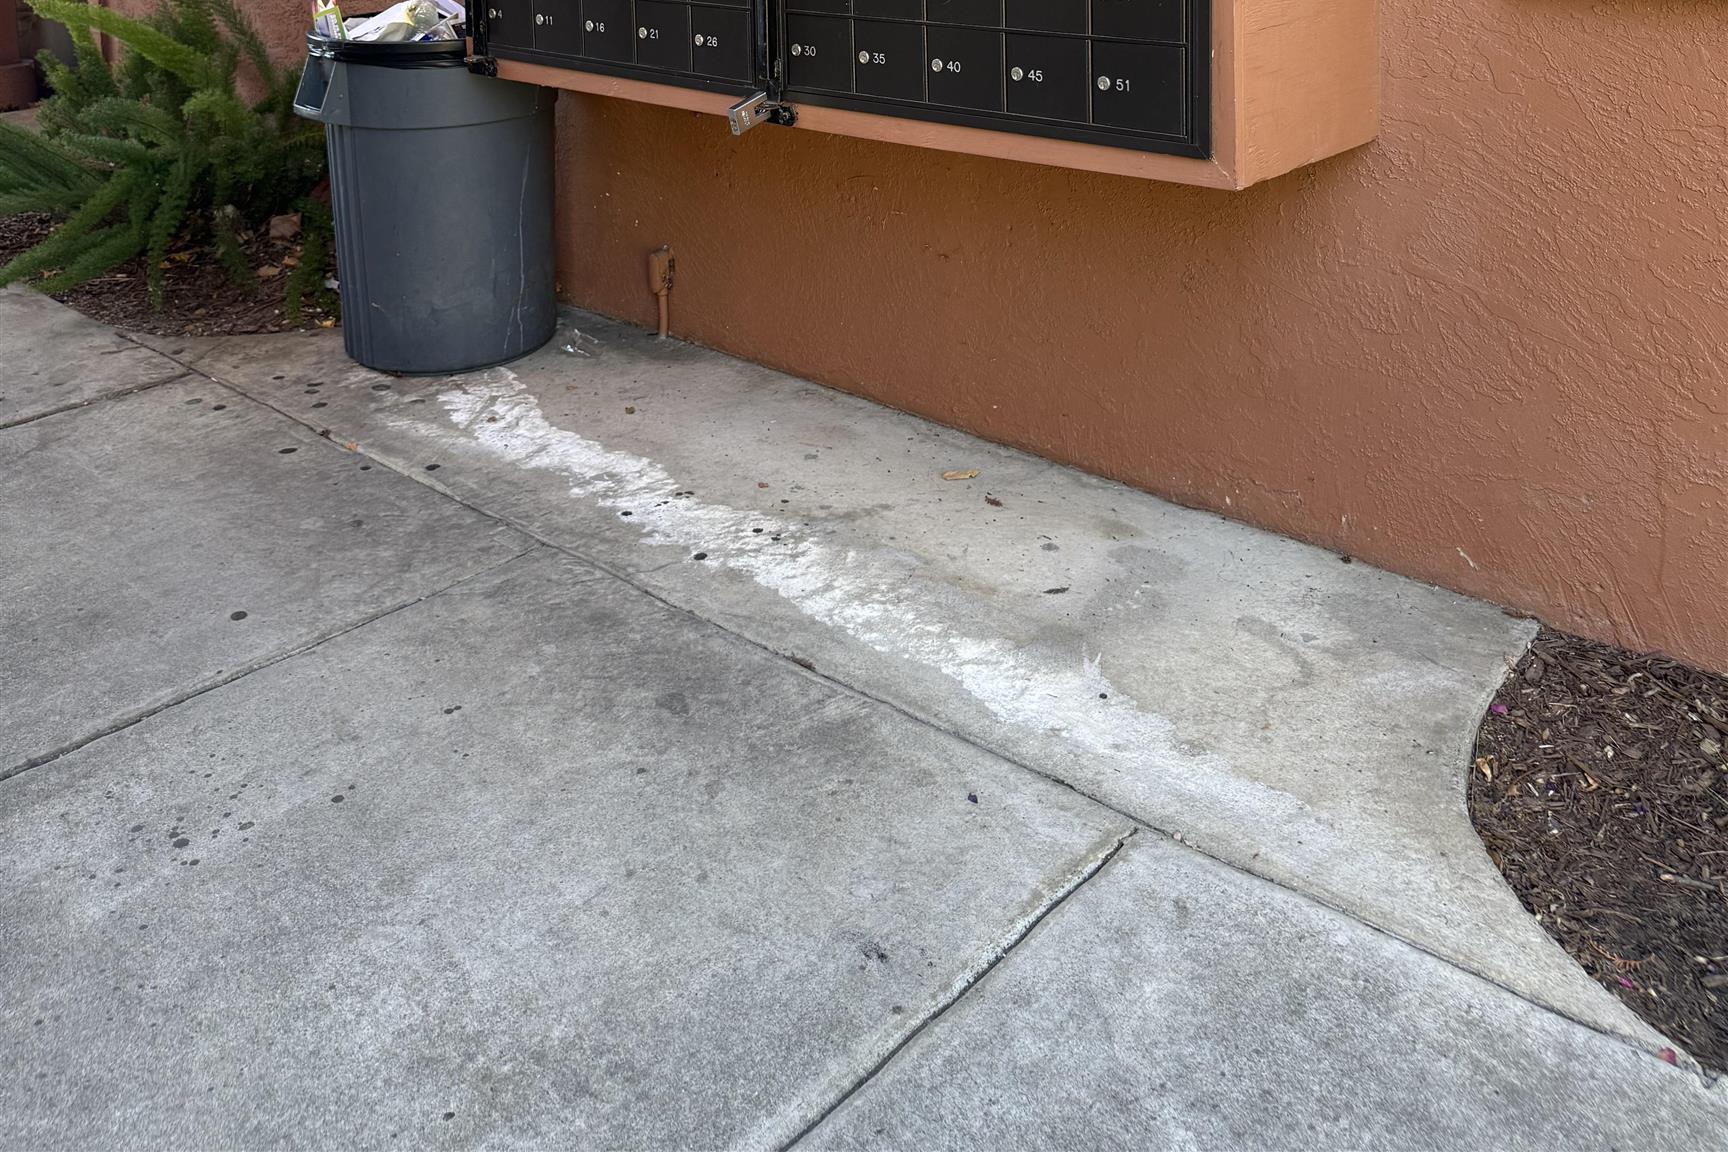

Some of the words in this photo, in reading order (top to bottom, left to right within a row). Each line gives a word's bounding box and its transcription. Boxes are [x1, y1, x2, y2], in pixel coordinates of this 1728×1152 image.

[497, 9, 503, 19] 4
[545, 15, 553, 26] 11
[595, 22, 605, 33] 16
[649, 28, 659, 39] 21
[706, 35, 718, 47] 26
[803, 45, 817, 57] 30
[872, 52, 886, 65] 35
[946, 60, 961, 73] 40
[1027, 69, 1043, 82] 45
[1115, 78, 1130, 92] 51
